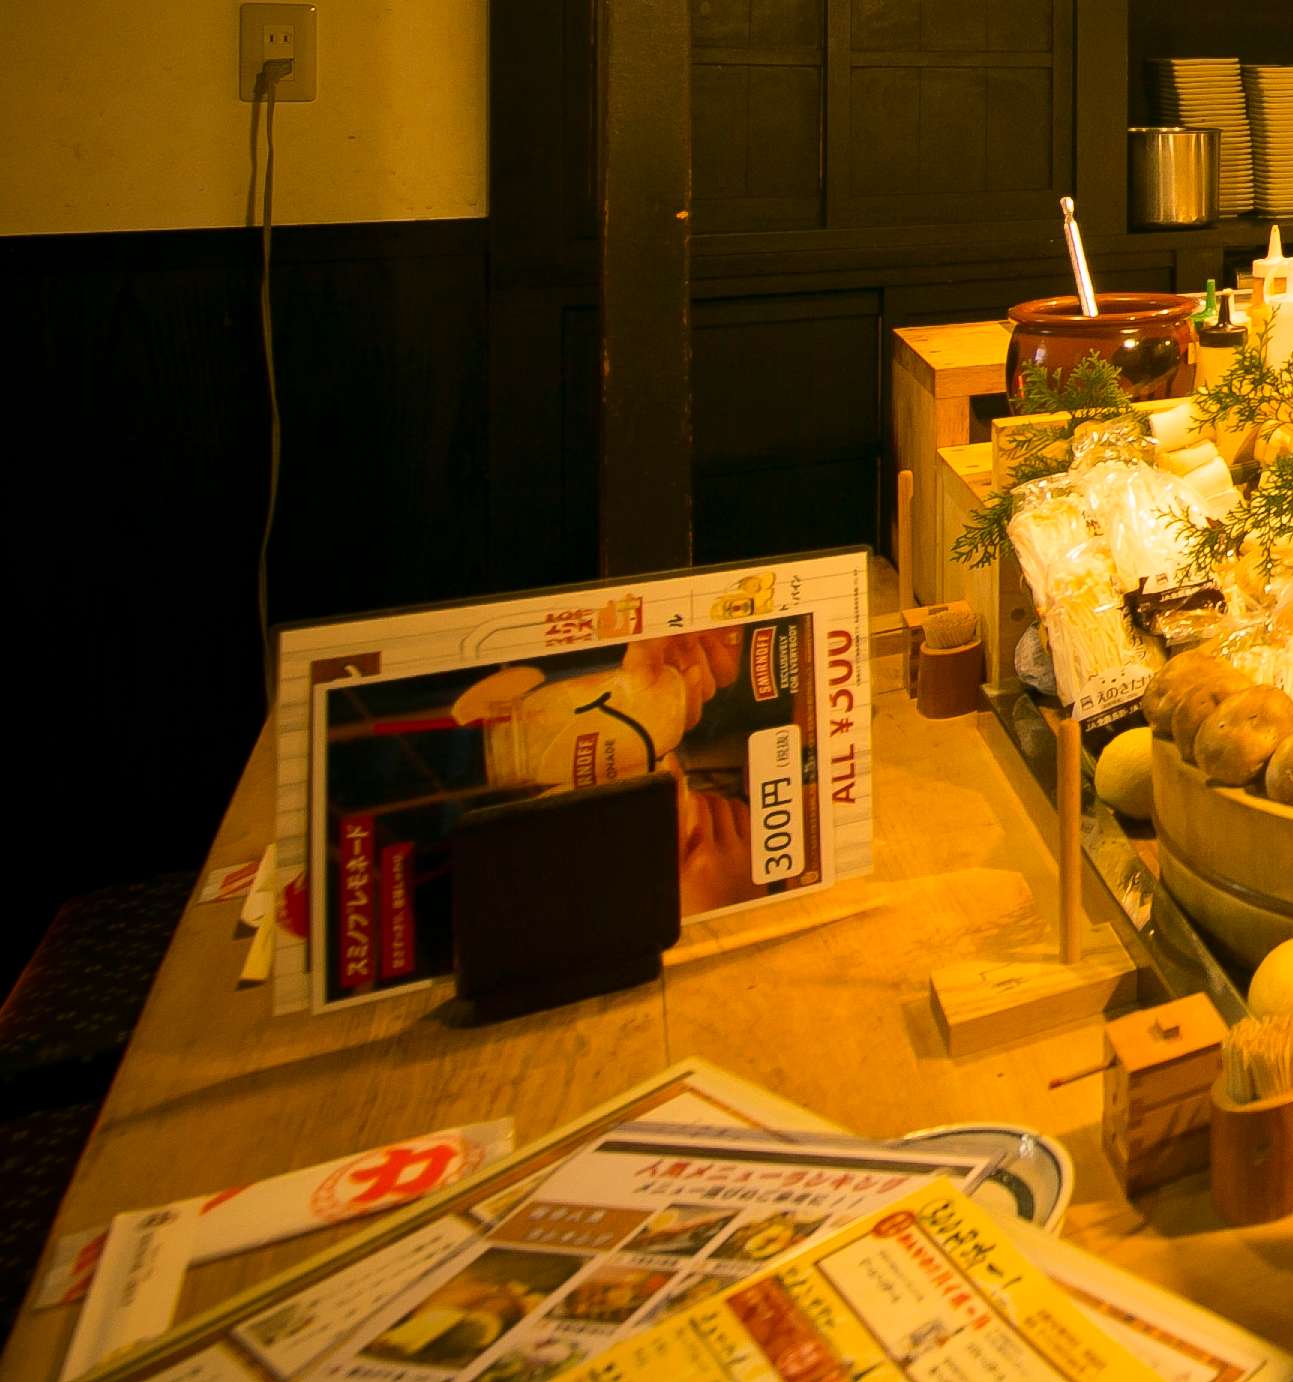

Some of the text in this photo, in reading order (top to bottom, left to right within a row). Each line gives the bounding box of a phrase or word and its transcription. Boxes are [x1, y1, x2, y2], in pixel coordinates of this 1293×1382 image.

[755, 629, 775, 700] SMIRNOFF
[779, 634, 788, 690] EXCLUSIVELY
[789, 624, 799, 694] FOR EVERYBODY
[830, 742, 856, 804] ALL
[758, 777, 794, 876] 300円
[635, 1158, 907, 1195] 人気メニューランキング
